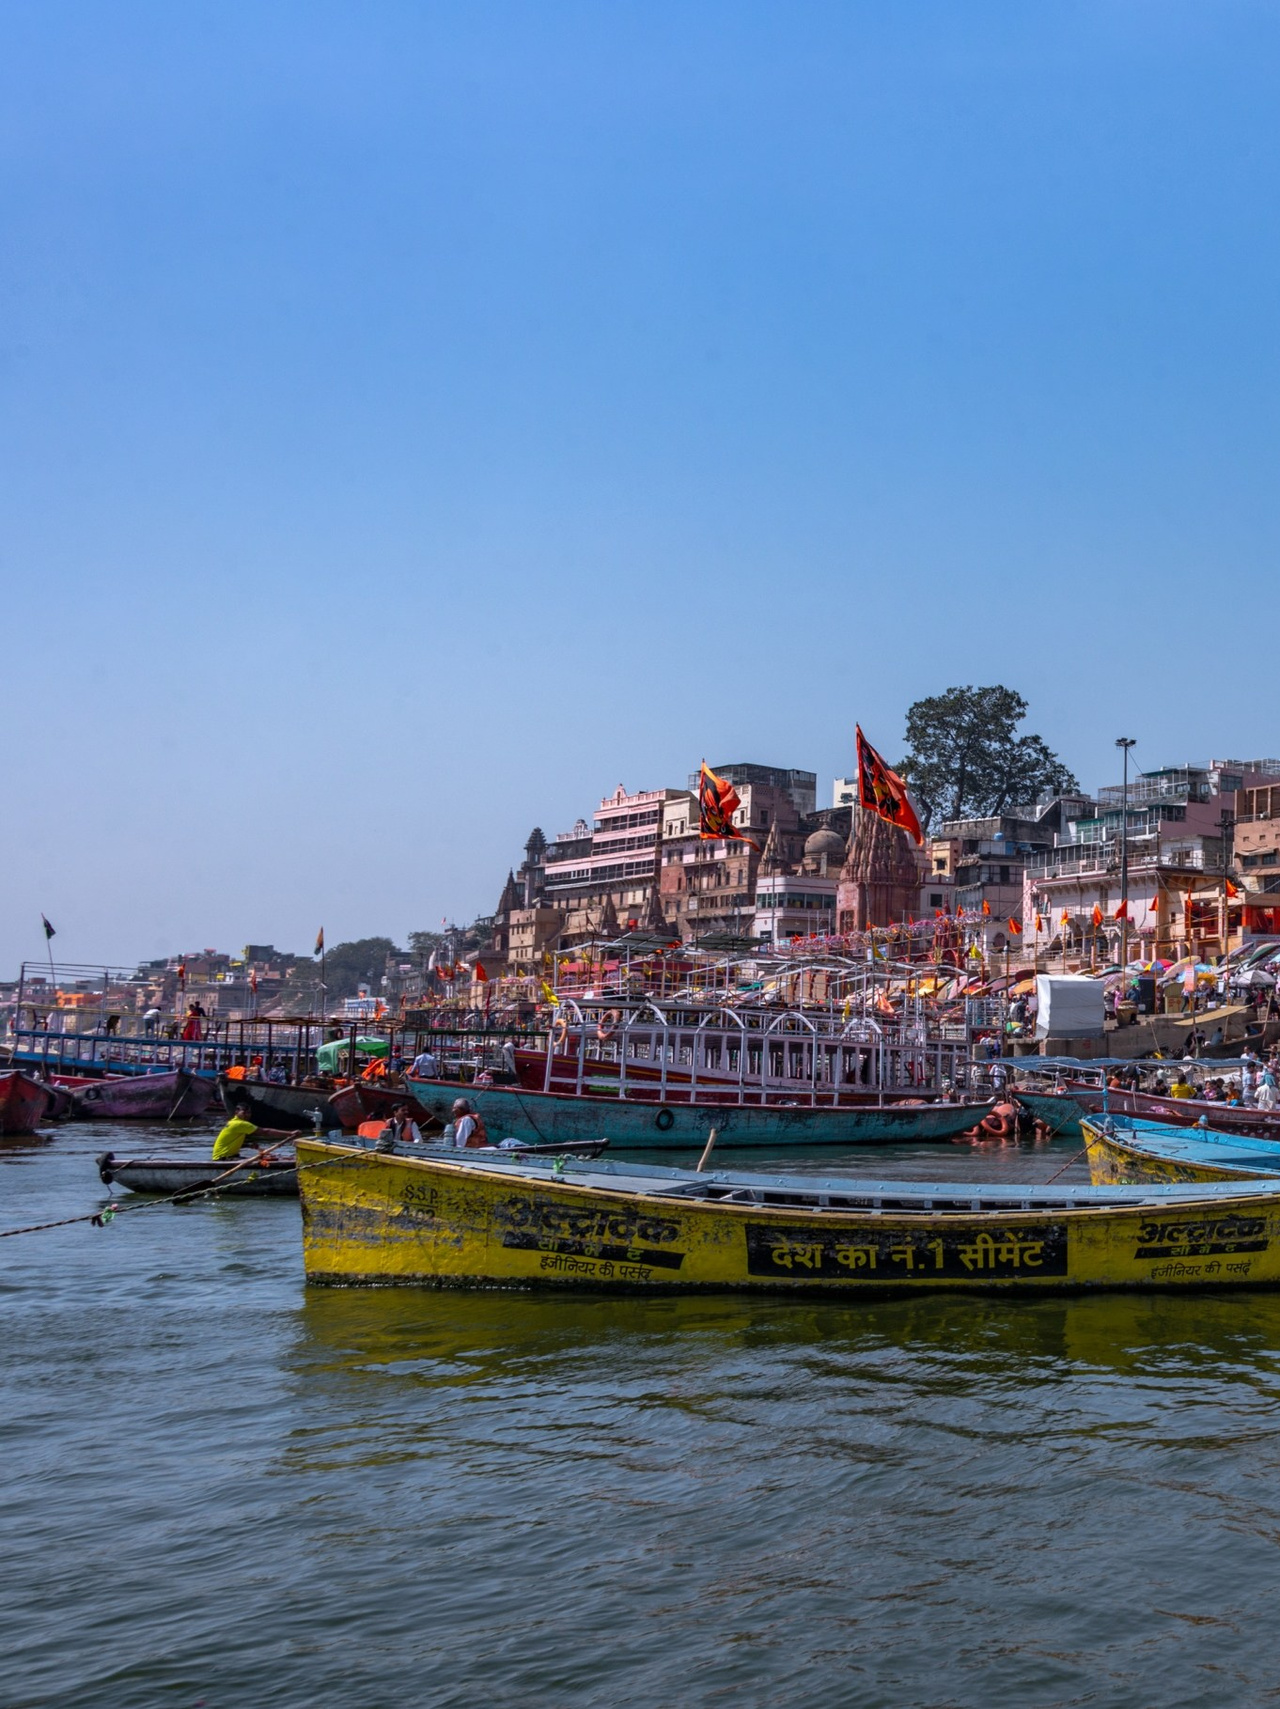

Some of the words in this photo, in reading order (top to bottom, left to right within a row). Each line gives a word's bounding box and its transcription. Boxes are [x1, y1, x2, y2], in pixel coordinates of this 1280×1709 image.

[770, 1232, 825, 1269] देश
[835, 1244, 879, 1269] का
[957, 1232, 1045, 1271] सीमेंट
[540, 1255, 596, 1276] इंजीनियर
[599, 1263, 614, 1278] की
[619, 1264, 654, 1280] पसंद
[1151, 1262, 1201, 1279] इंजीनियर
[1205, 1260, 1221, 1274] की
